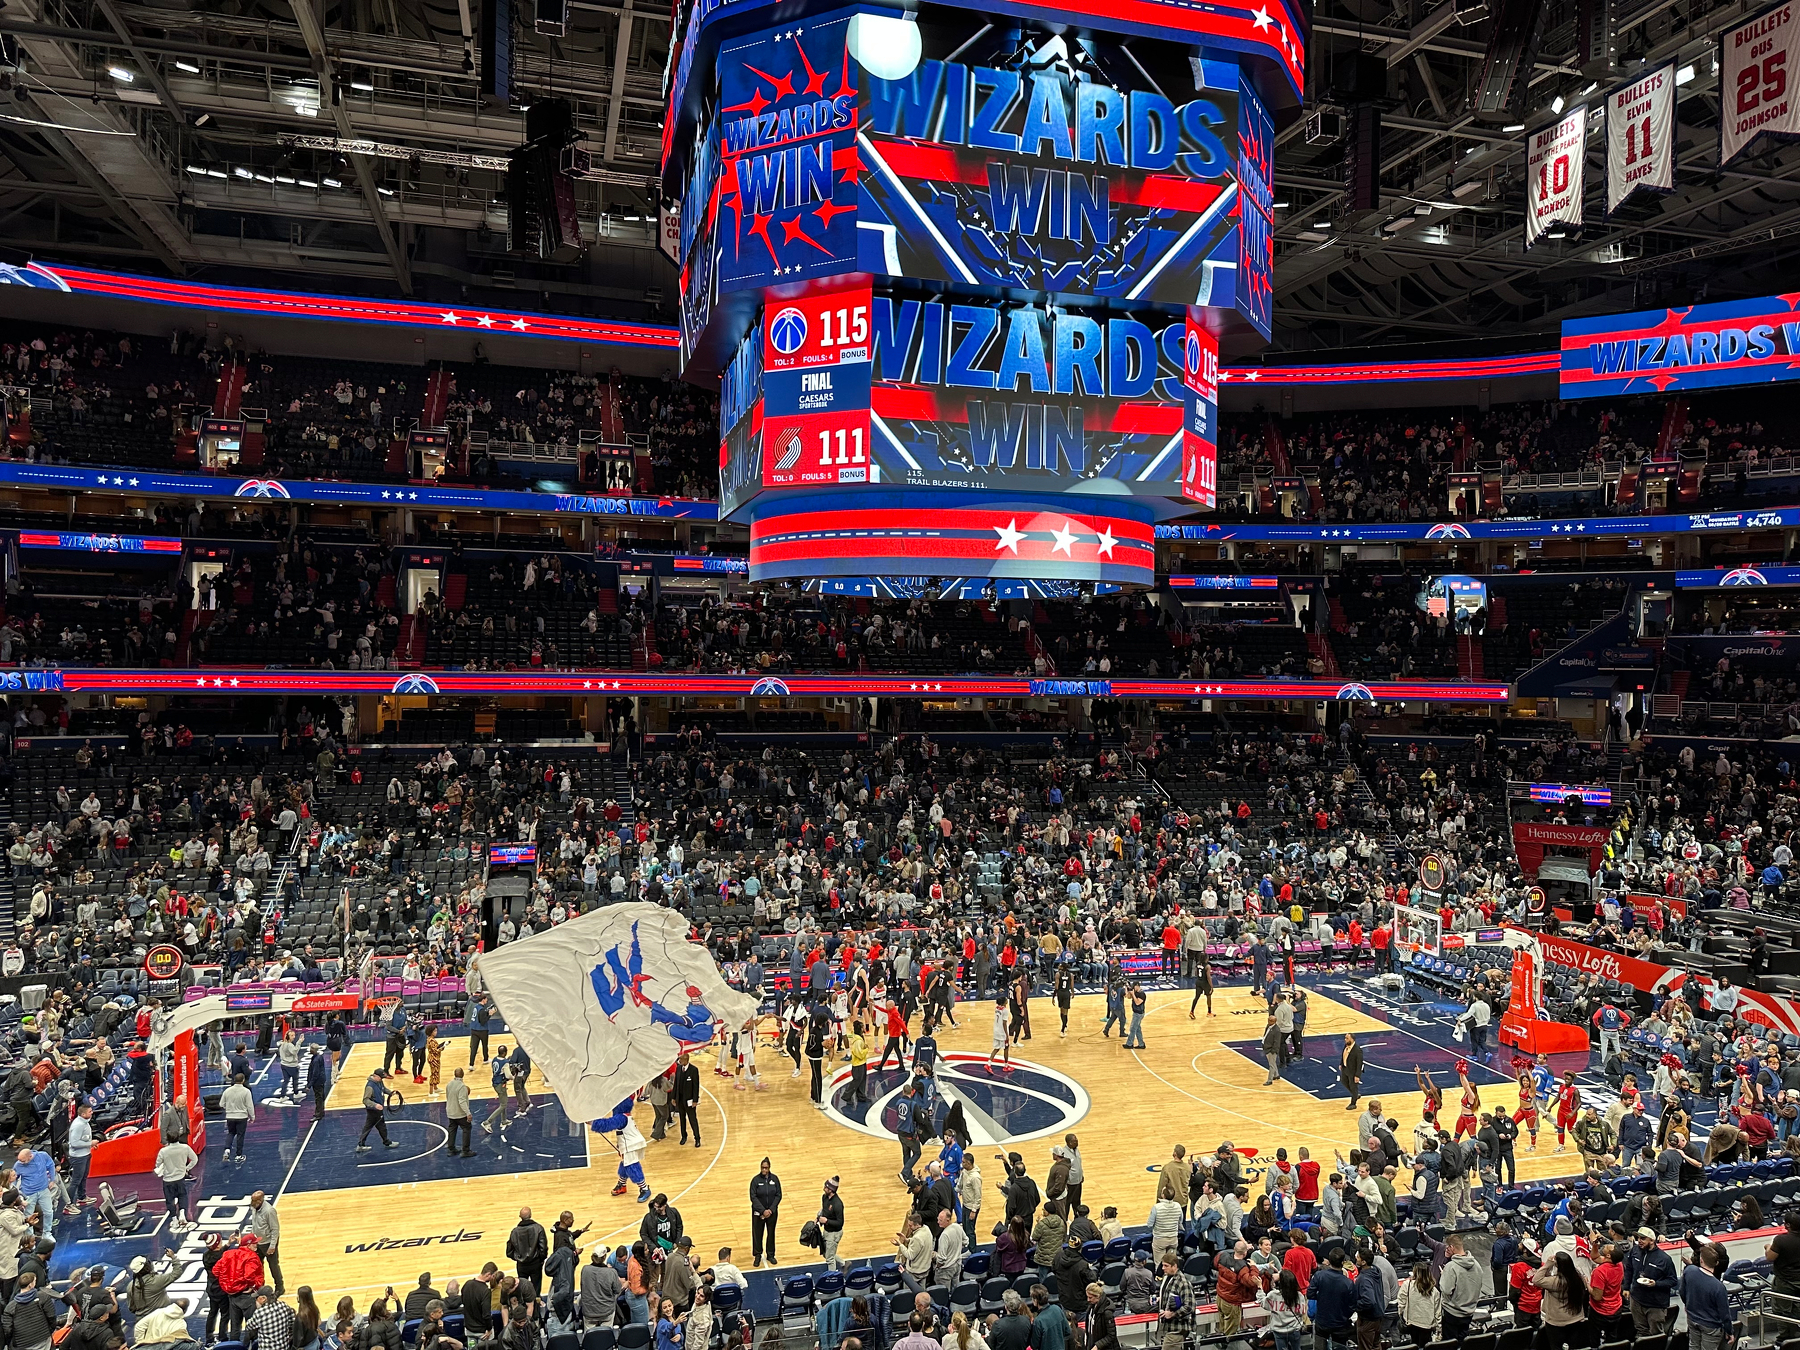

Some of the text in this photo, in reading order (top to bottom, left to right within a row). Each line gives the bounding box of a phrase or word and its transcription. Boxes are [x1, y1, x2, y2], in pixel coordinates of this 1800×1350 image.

[1735, 6, 1791, 48] BULLETS
[1750, 38, 1773, 59] GUS
[1617, 73, 1663, 108] BULLETS
[1736, 49, 1787, 116] 25
[869, 60, 1228, 178] WIZARDS
[1626, 99, 1653, 121] ELVIN
[1735, 101, 1788, 136] JOHNSON
[723, 94, 853, 154] WIZARDS
[1536, 118, 1576, 149] BULLETS
[1625, 116, 1653, 166] 11
[1529, 152, 1544, 166] EARL
[735, 139, 834, 217] WIN
[1538, 153, 1570, 202] 10
[1625, 163, 1653, 184] HAYES
[987, 163, 1110, 246] WIN
[1536, 196, 1570, 219] MONROE
[819, 305, 868, 347] 115
[790, 357, 795, 365] 2
[802, 354, 828, 364] FOULS:
[840, 349, 866, 359] BONUS
[871, 296, 1185, 402] WIZARDS
[1589, 324, 1775, 375] WIZARDS
[801, 371, 833, 392] FINAL
[798, 392, 834, 403] CAESARS
[798, 400, 828, 410] SPORTSBOOK
[966, 399, 1085, 472] WIN
[818, 427, 866, 466] 111
[801, 473, 827, 481] FOULS:
[839, 469, 865, 479] BONUS
[906, 477, 930, 486] TRAIL
[932, 479, 968, 488] BLAZERS
[556, 495, 660, 515] WIZARDS WIN
[1154, 525, 1208, 539] RDS WIN
[1746, 516, 1782, 527] $4,740
[59, 534, 144, 551] WIZARDS WIN
[703, 559, 747, 572] WIZARDS
[1195, 576, 1234, 588] WIZARDS
[24, 671, 64, 691] WIN
[1029, 680, 1111, 695] WIZARDS WIN
[1583, 793, 1601, 801] WIN
[1528, 827, 1605, 844] Hennessy Lofts
[156, 953, 172, 963] 0.0
[1582, 950, 1622, 978] Lofts
[344, 1228, 486, 1254] wizards
